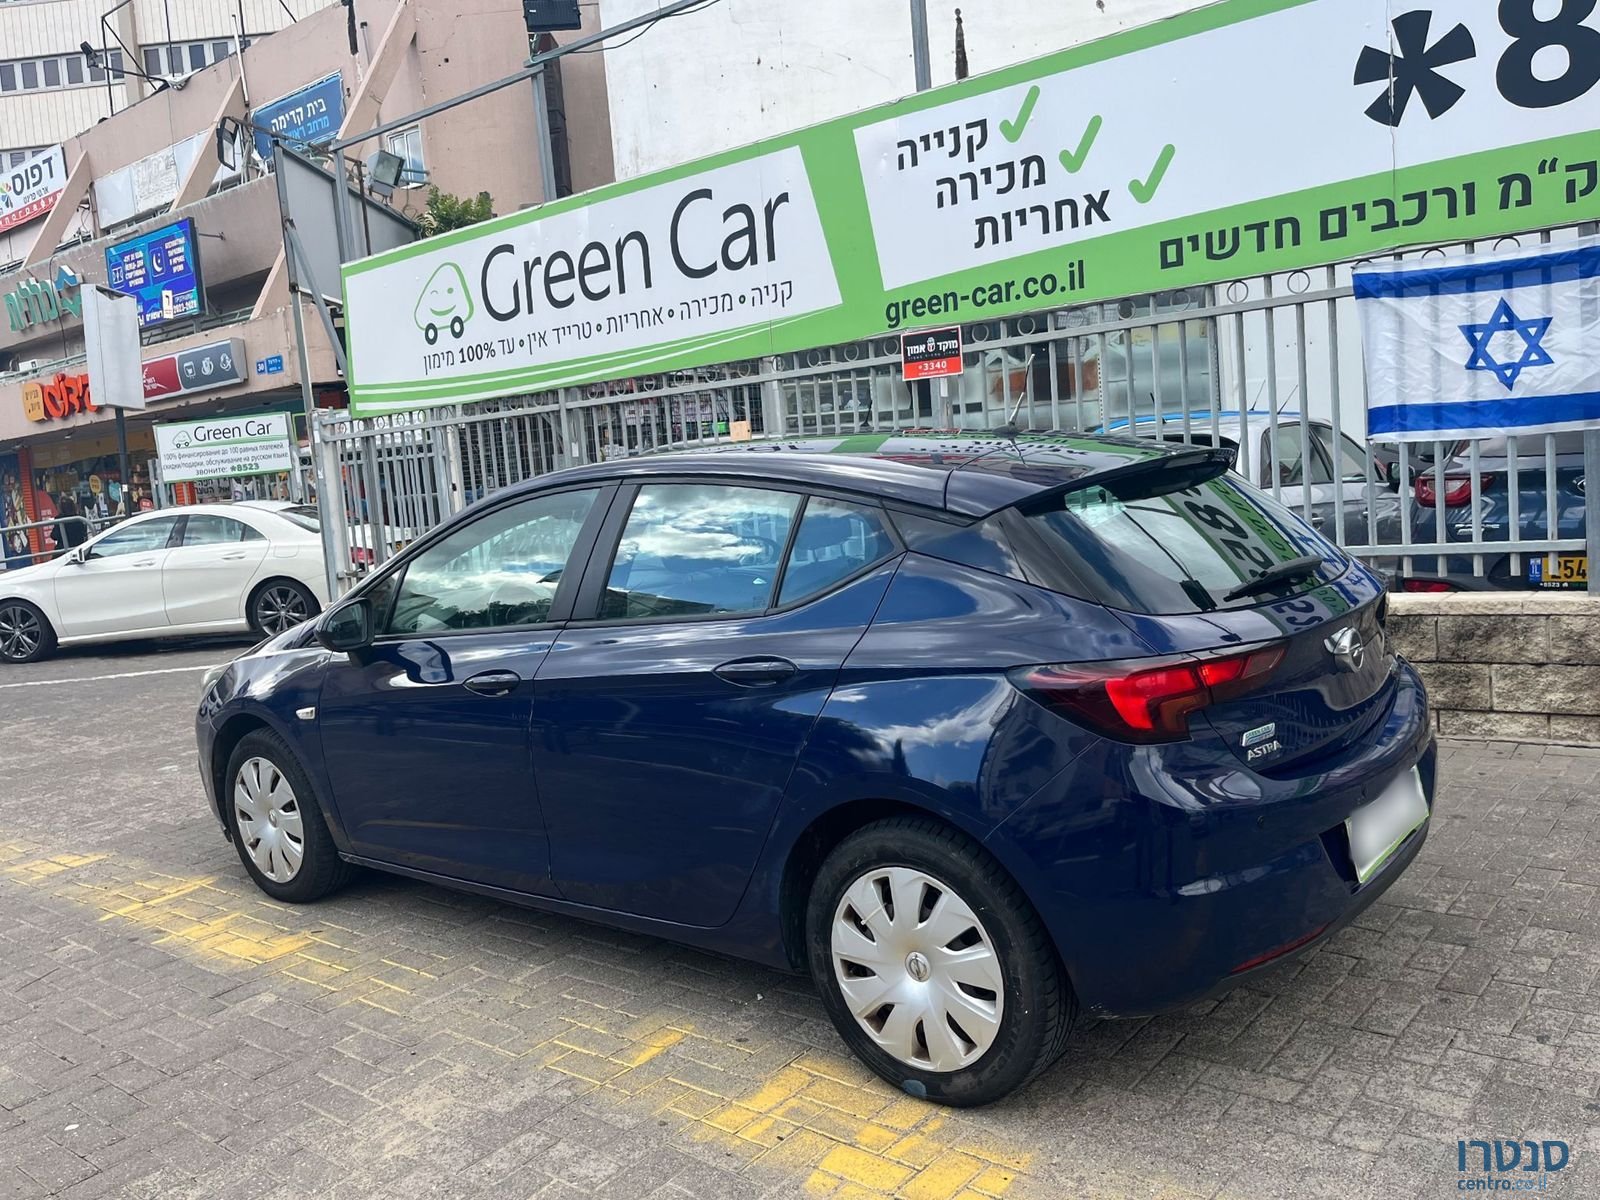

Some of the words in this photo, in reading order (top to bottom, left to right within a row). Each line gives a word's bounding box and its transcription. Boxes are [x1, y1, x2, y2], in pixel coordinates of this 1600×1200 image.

[271, 107, 304, 133] קדימה
[307, 98, 327, 118] בית
[307, 115, 330, 135] מרחב
[897, 118, 988, 171] קנייה
[11, 156, 54, 196] דפוס
[936, 154, 1046, 208] מכירה
[974, 189, 1111, 249] אחריות
[1320, 182, 1476, 242] ורכבים
[481, 230, 653, 321] Green
[670, 188, 790, 280] Car
[1160, 216, 1301, 270] חדשים
[4, 277, 59, 332] כללית
[680, 291, 733, 321] מכירה
[751, 279, 794, 308] קניה
[886, 260, 1085, 328] green-car.co.il
[552, 322, 592, 345] טרייד
[606, 306, 664, 335] אחריות
[459, 341, 496, 363] 100%
[497, 335, 516, 355] עד
[527, 330, 548, 356] אין
[906, 344, 926, 357] אמון
[936, 340, 958, 352] מוקד
[257, 362, 265, 372] 30
[423, 348, 455, 375] מימון
[194, 426, 241, 442] Green
[245, 420, 272, 437] Car
[196, 467, 228, 476] звоните:
[1248, 740, 1282, 761] ASTRA
